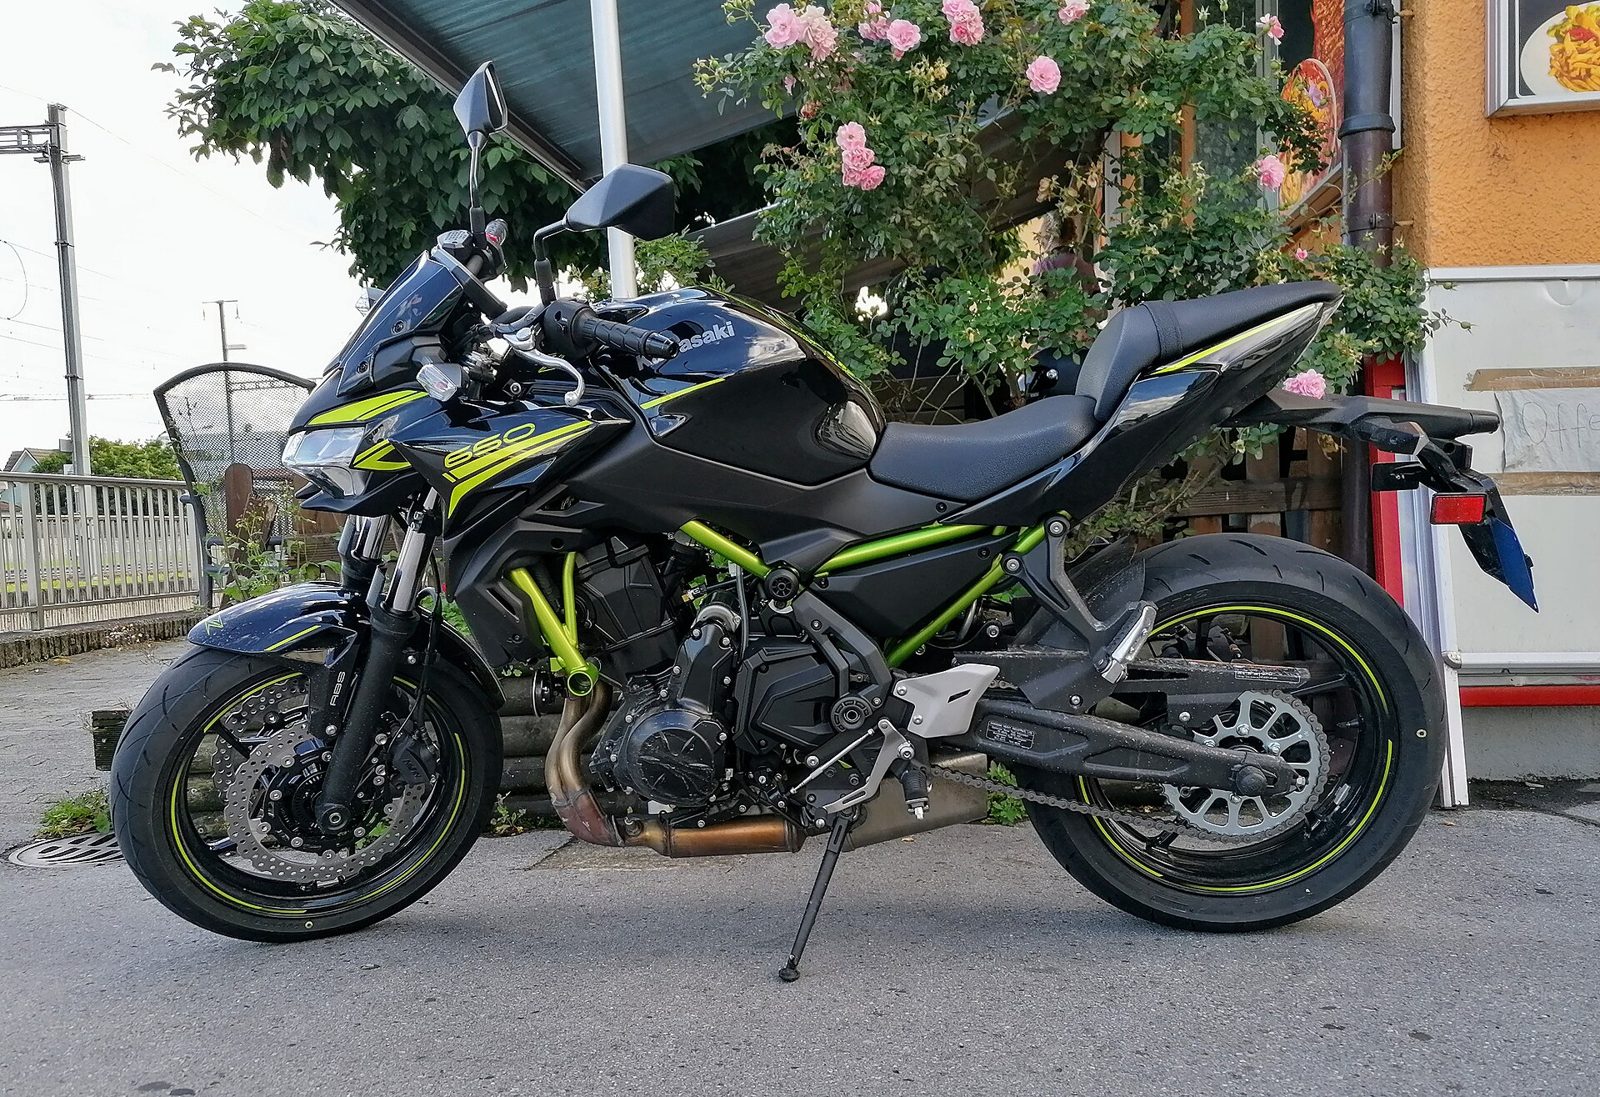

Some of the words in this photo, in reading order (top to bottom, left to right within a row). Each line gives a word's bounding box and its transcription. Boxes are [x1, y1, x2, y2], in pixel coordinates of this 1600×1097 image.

[636, 321, 735, 371] Kasaki
[444, 422, 536, 468] 650
[330, 671, 346, 706] ABS
